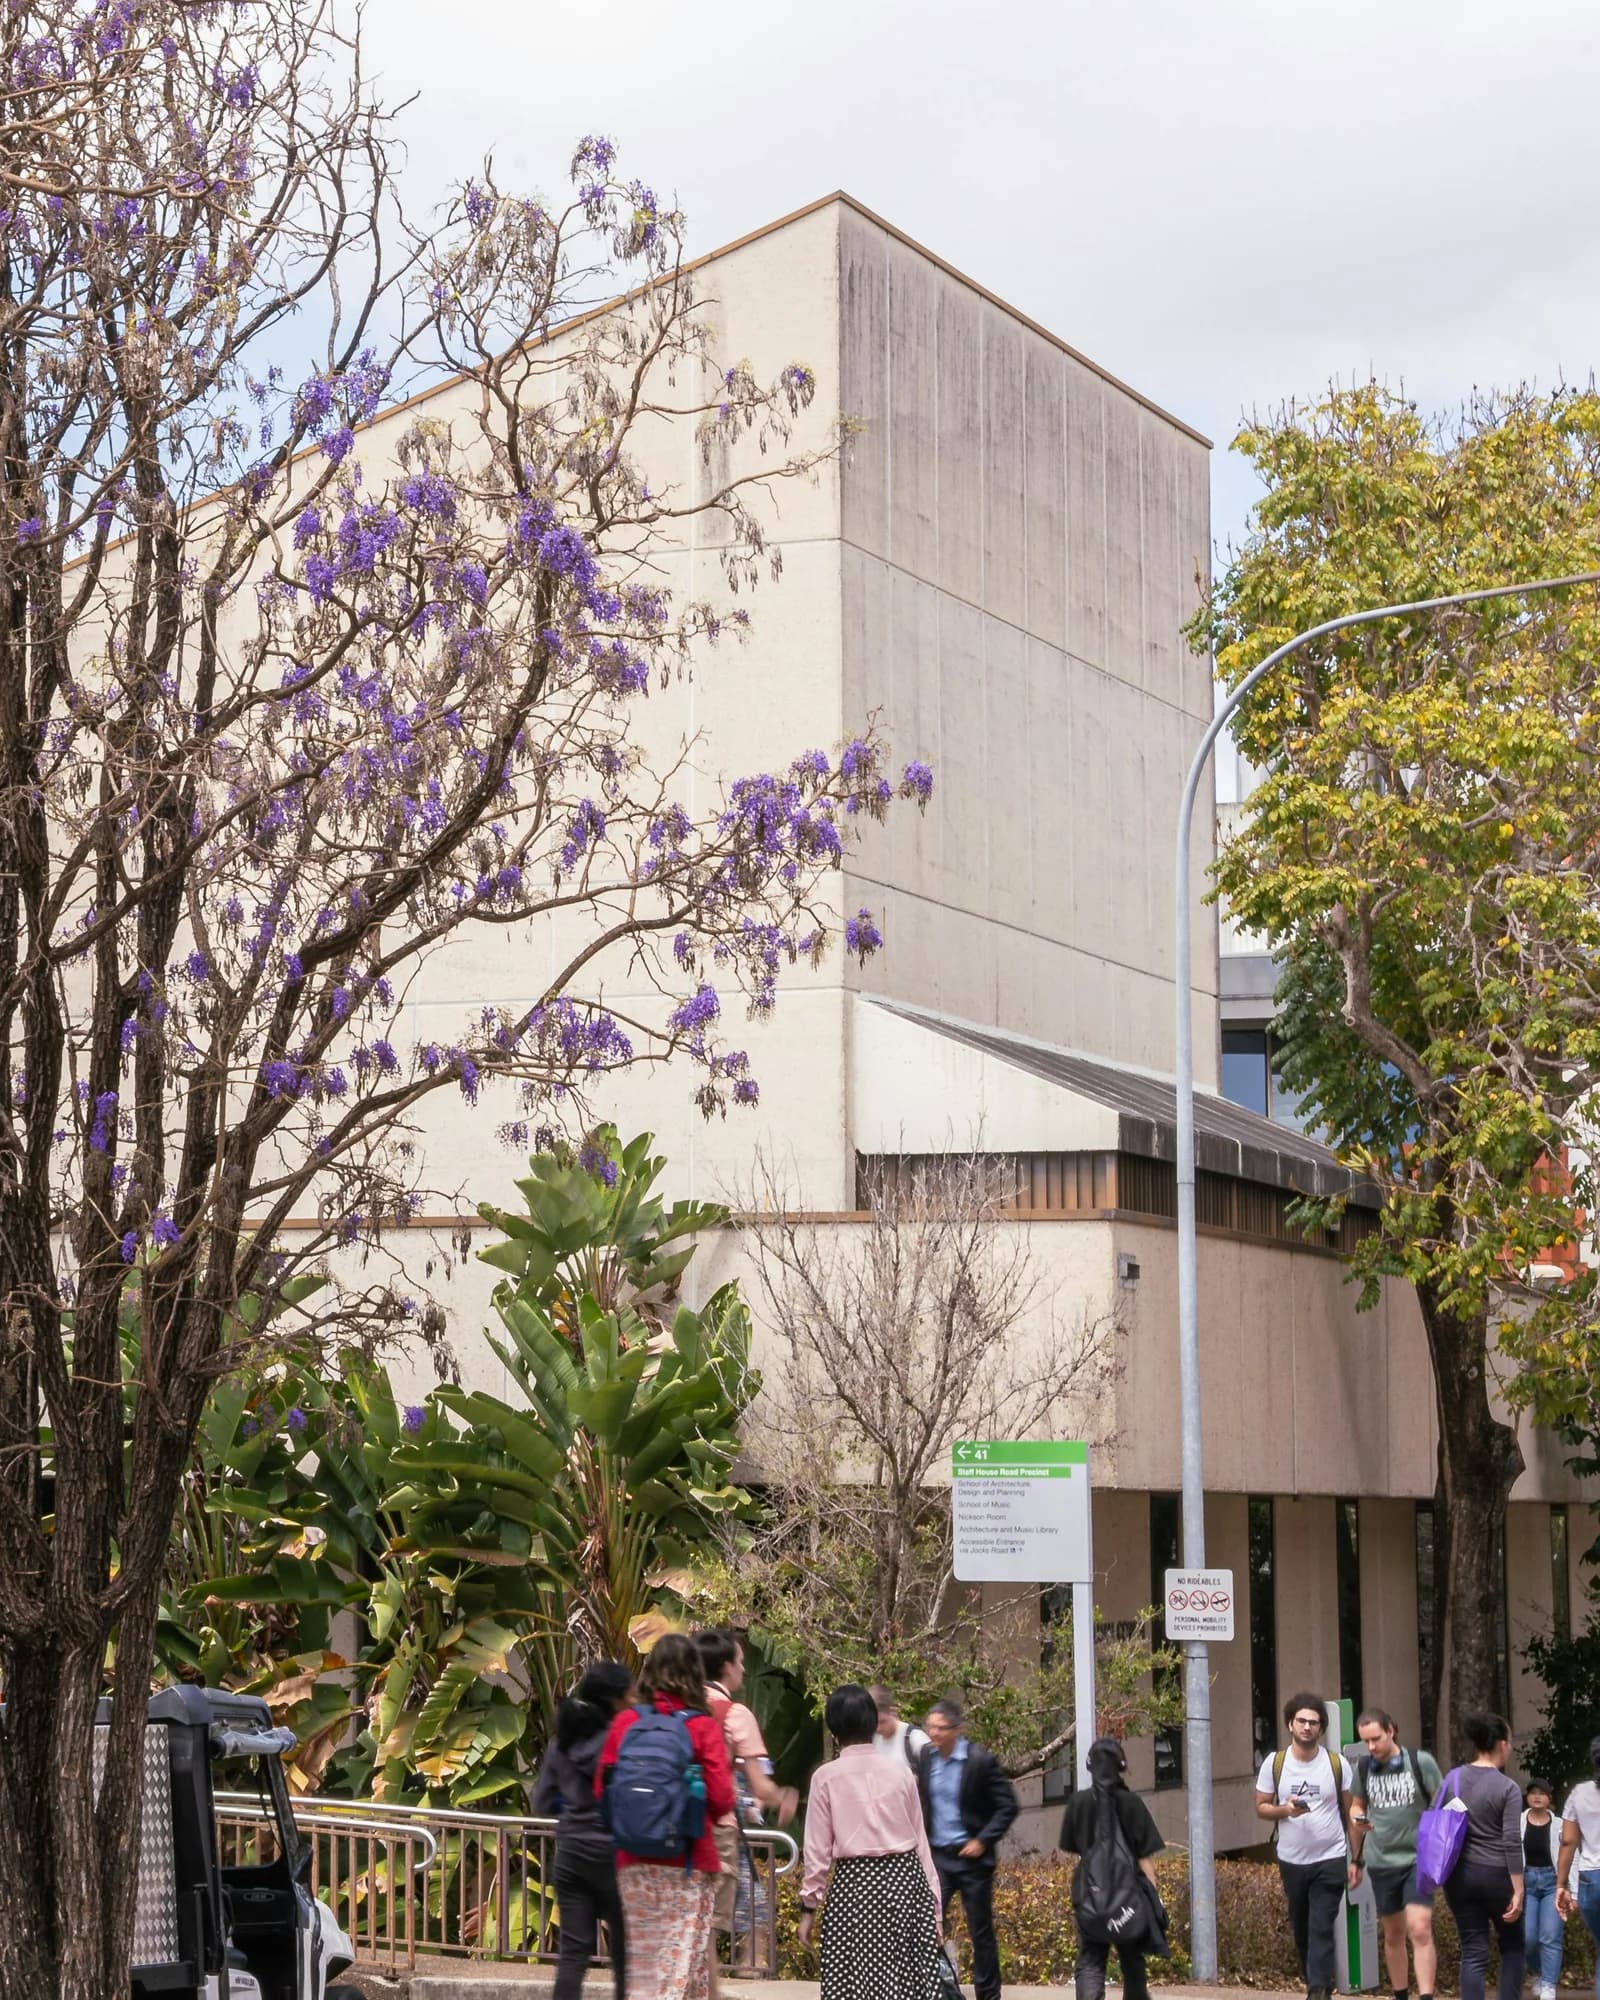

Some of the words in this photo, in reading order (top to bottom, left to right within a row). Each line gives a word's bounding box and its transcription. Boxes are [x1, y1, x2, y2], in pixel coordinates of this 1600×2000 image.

[974, 1449, 988, 1460] 41
[957, 1468, 974, 1476] Staff
[976, 1468, 998, 1476] House
[1000, 1468, 1018, 1476] Road
[1019, 1468, 1049, 1476] Precinct
[958, 1489, 980, 1497] Design
[997, 1489, 1025, 1497] Planning
[1035, 1526, 1059, 1535] Library
[1106, 1905, 1136, 1934] Fender
